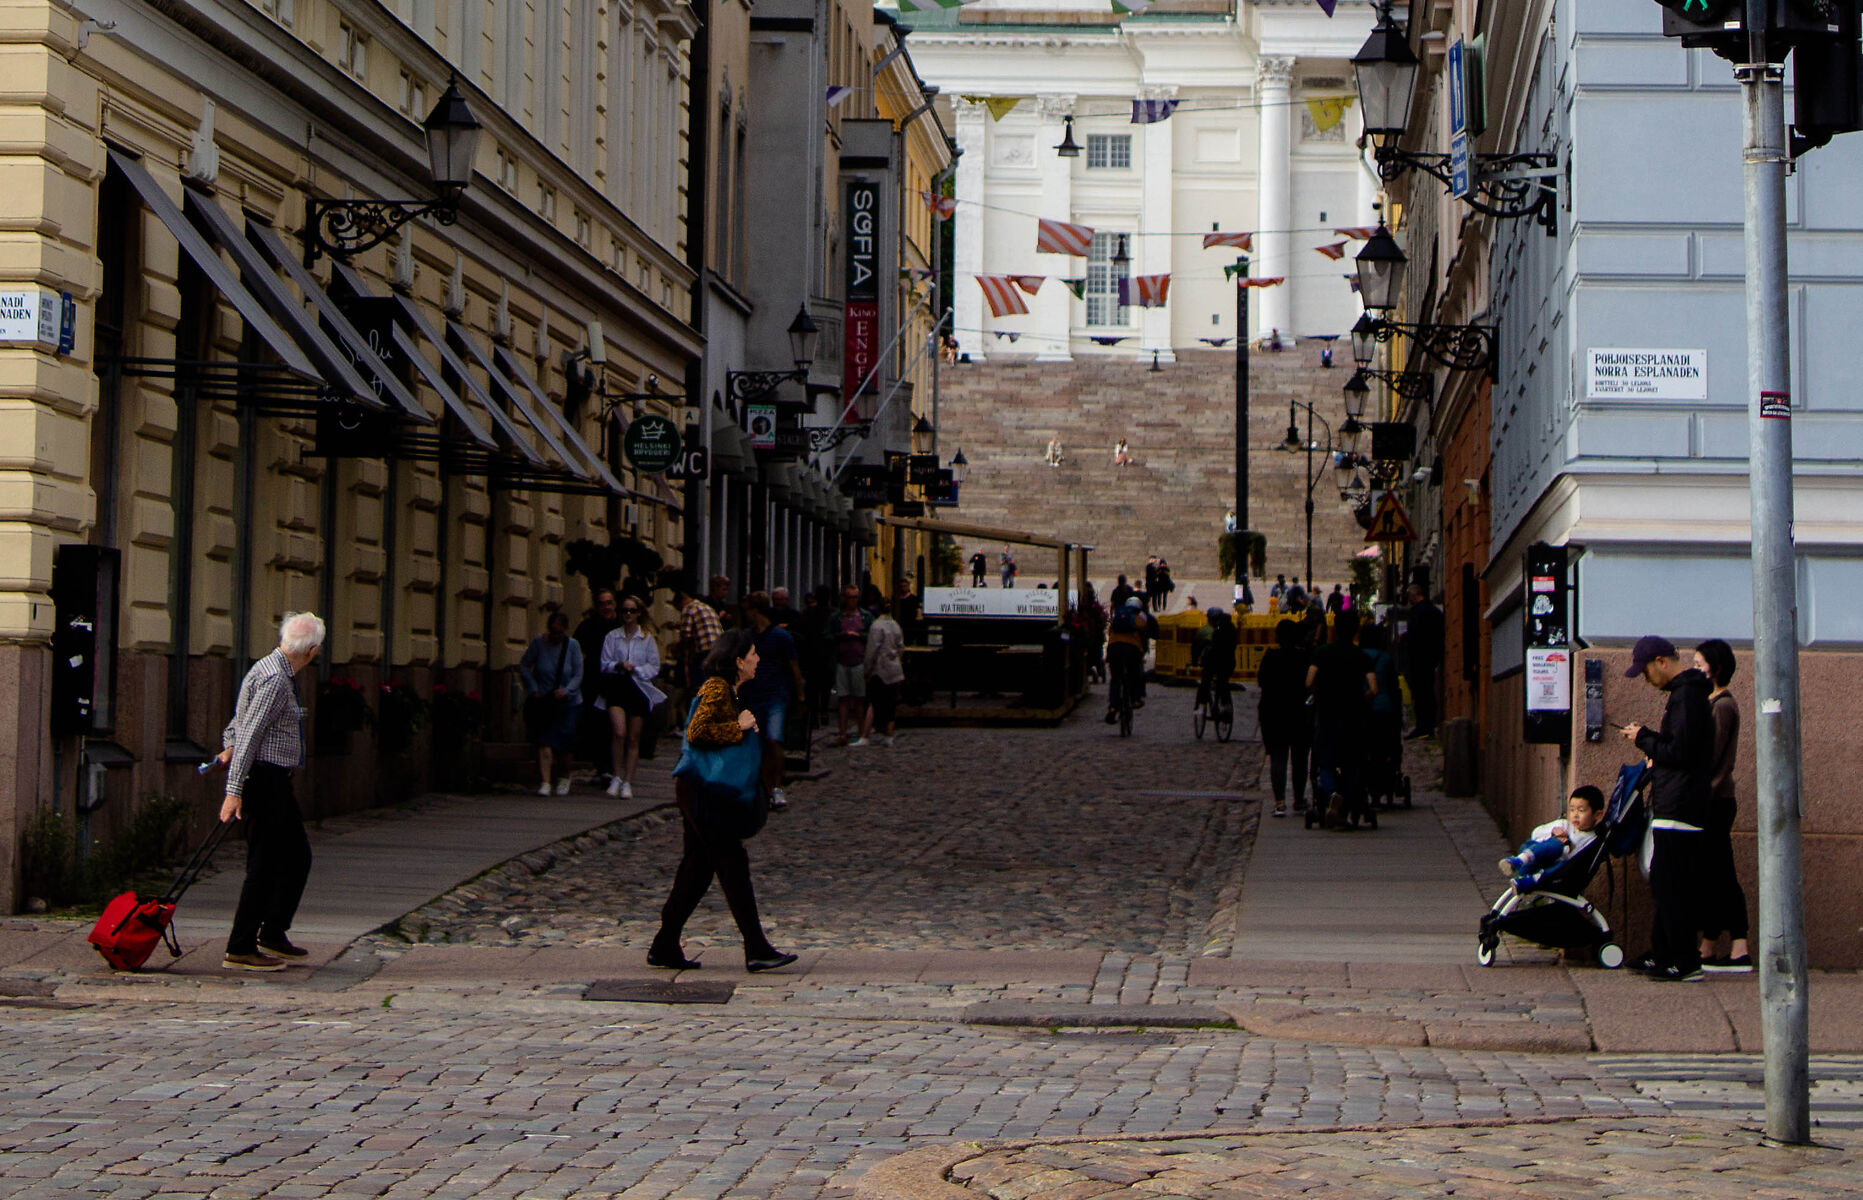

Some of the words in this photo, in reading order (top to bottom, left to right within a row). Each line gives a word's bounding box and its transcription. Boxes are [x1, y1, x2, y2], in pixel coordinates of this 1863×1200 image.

[853, 189, 873, 286] SOFIA
[855, 320, 869, 385] ENGE
[1595, 353, 1691, 366] POHJOISESPLANADI
[1595, 366, 1628, 377] NORRA
[1634, 366, 1700, 378] ESPLANADEN
[672, 451, 703, 475] WC
[940, 603, 952, 613] VIA
[1017, 604, 1028, 614] VIA
